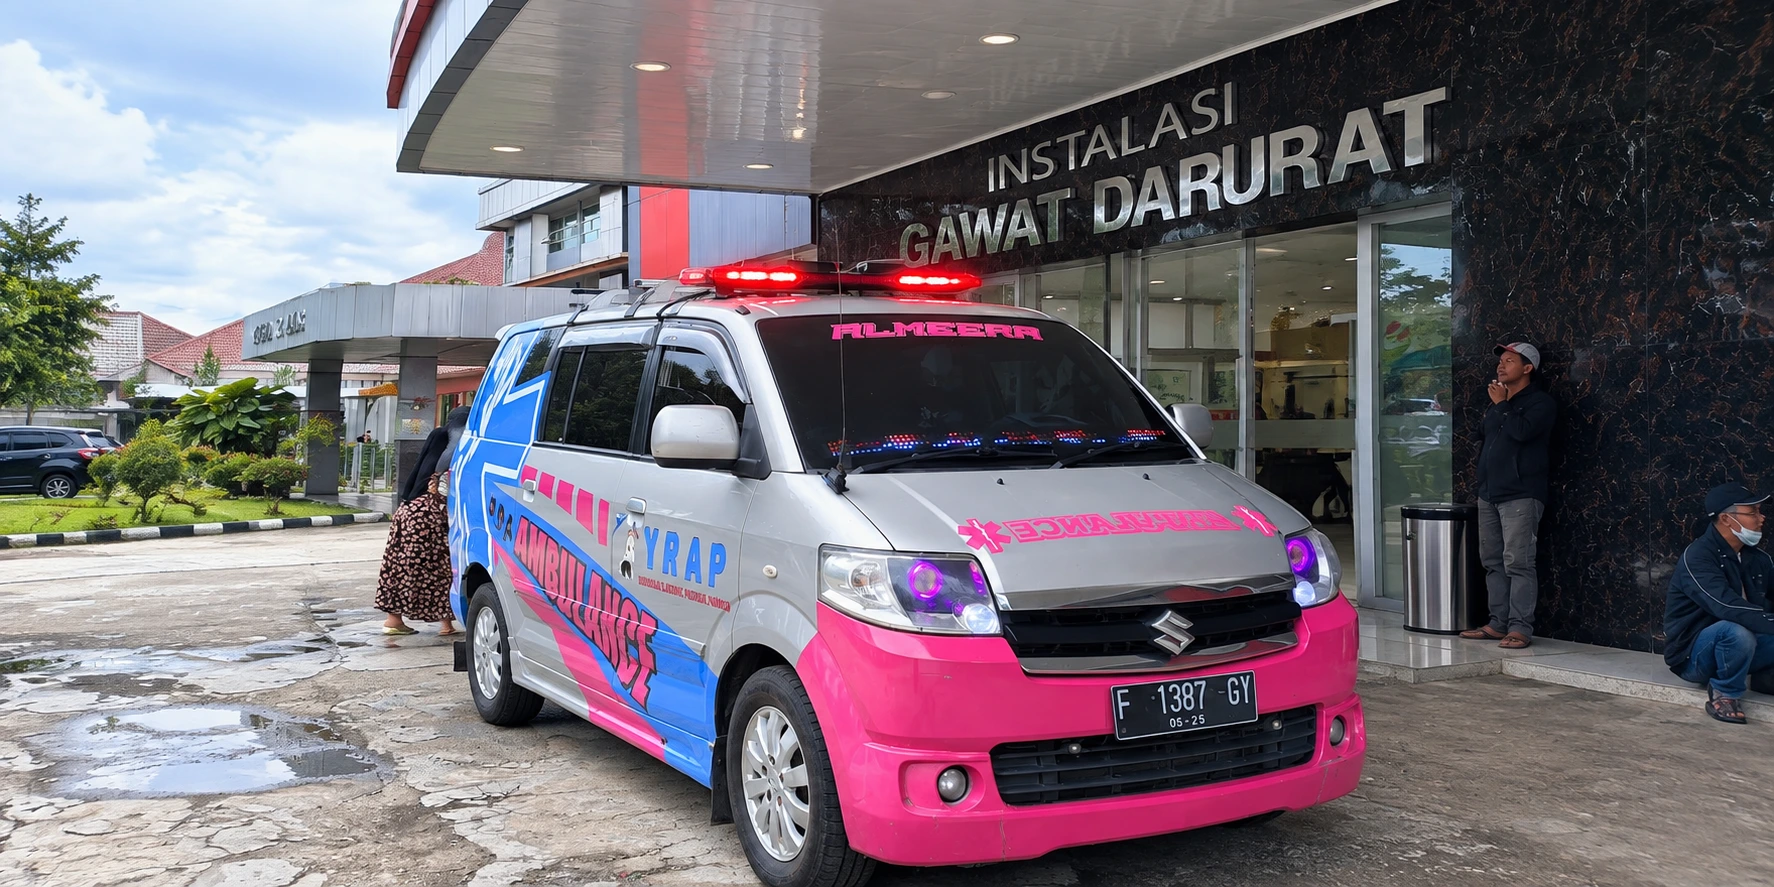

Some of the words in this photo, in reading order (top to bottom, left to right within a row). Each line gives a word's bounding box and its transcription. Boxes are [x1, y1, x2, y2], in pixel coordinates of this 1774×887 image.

[899, 188, 1072, 269] GAWAT
[1093, 86, 1450, 235] DARURAT
[987, 82, 1236, 193] INSTALASI
[831, 321, 1044, 341] ALMEERA
[644, 526, 727, 588] YRAP
[514, 516, 658, 711] AMBULANCE
[1116, 689, 1130, 720] F
[1157, 680, 1207, 715] 1387
[1227, 675, 1251, 706] GY
